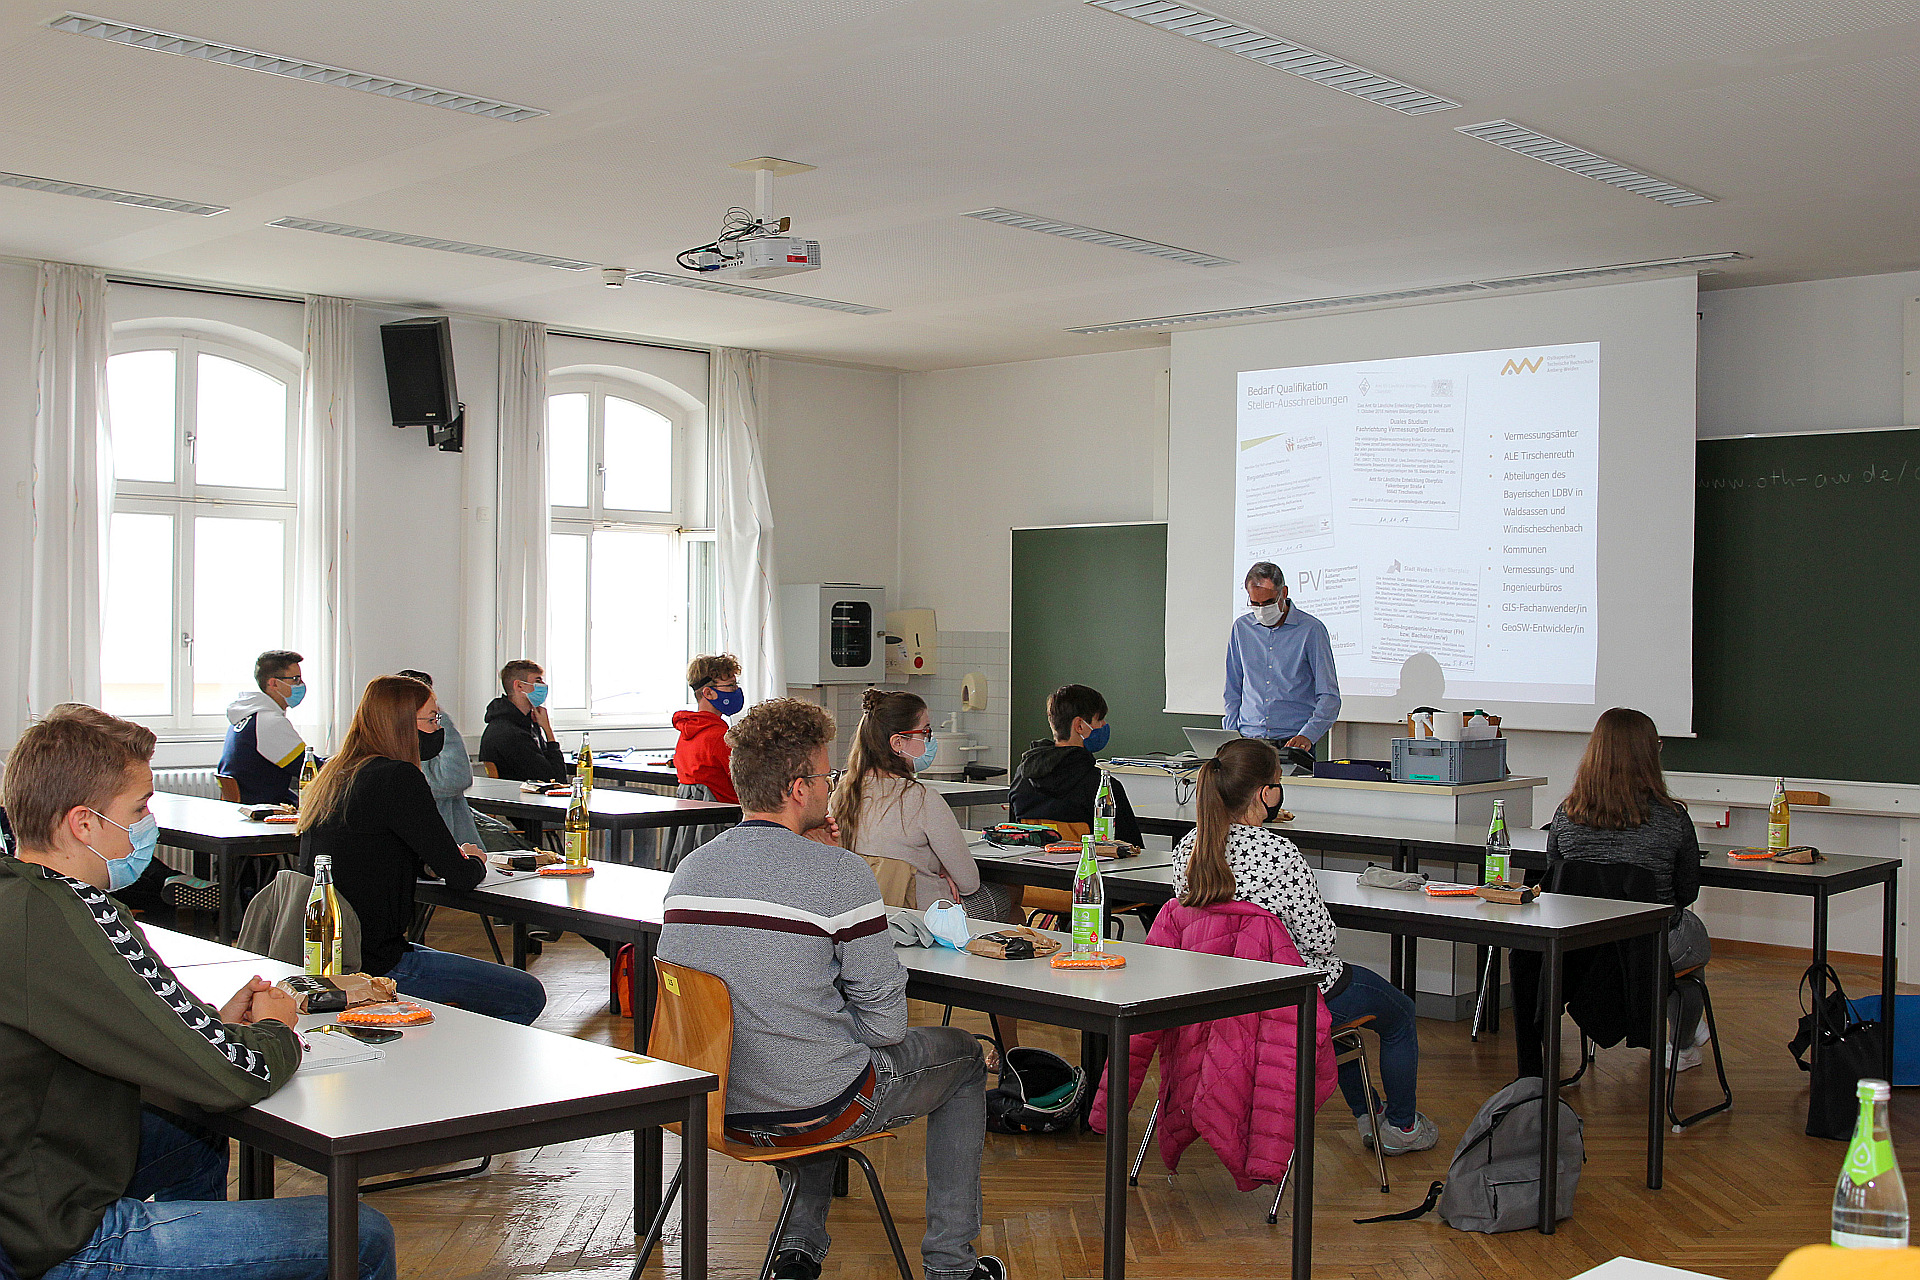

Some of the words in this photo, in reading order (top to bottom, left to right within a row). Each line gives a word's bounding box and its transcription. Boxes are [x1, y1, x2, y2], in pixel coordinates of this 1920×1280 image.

[1247, 384, 1275, 397] Bedarf
[1276, 381, 1329, 396] Qualifikation
[1247, 395, 1349, 411] Stellen-Ausschreibungen
[1355, 425, 1388, 434] Fachrichtung
[1503, 429, 1579, 441] Vermessungsämter
[1503, 451, 1519, 461] ALE
[1520, 449, 1575, 460] Tirschenreuth
[1503, 471, 1550, 482] Abteilungen
[1551, 470, 1566, 479] des
[1503, 488, 1550, 500] Bayerischen
[1551, 487, 1574, 498] LDBV
[1575, 487, 1583, 497] in
[1503, 507, 1548, 517] Waldsassen
[1550, 505, 1566, 515] und
[1502, 523, 1583, 534] Windischeschenbach
[1502, 545, 1548, 554] Kommunen
[1502, 564, 1558, 576] Vermessungs-
[1559, 564, 1575, 574] und
[1298, 569, 1322, 593] PV
[1502, 582, 1563, 594] Ingenieurbüros
[1501, 602, 1588, 614] GIS-Fachanwender/in
[1501, 622, 1585, 635] GeoSW-Entwickler/in
